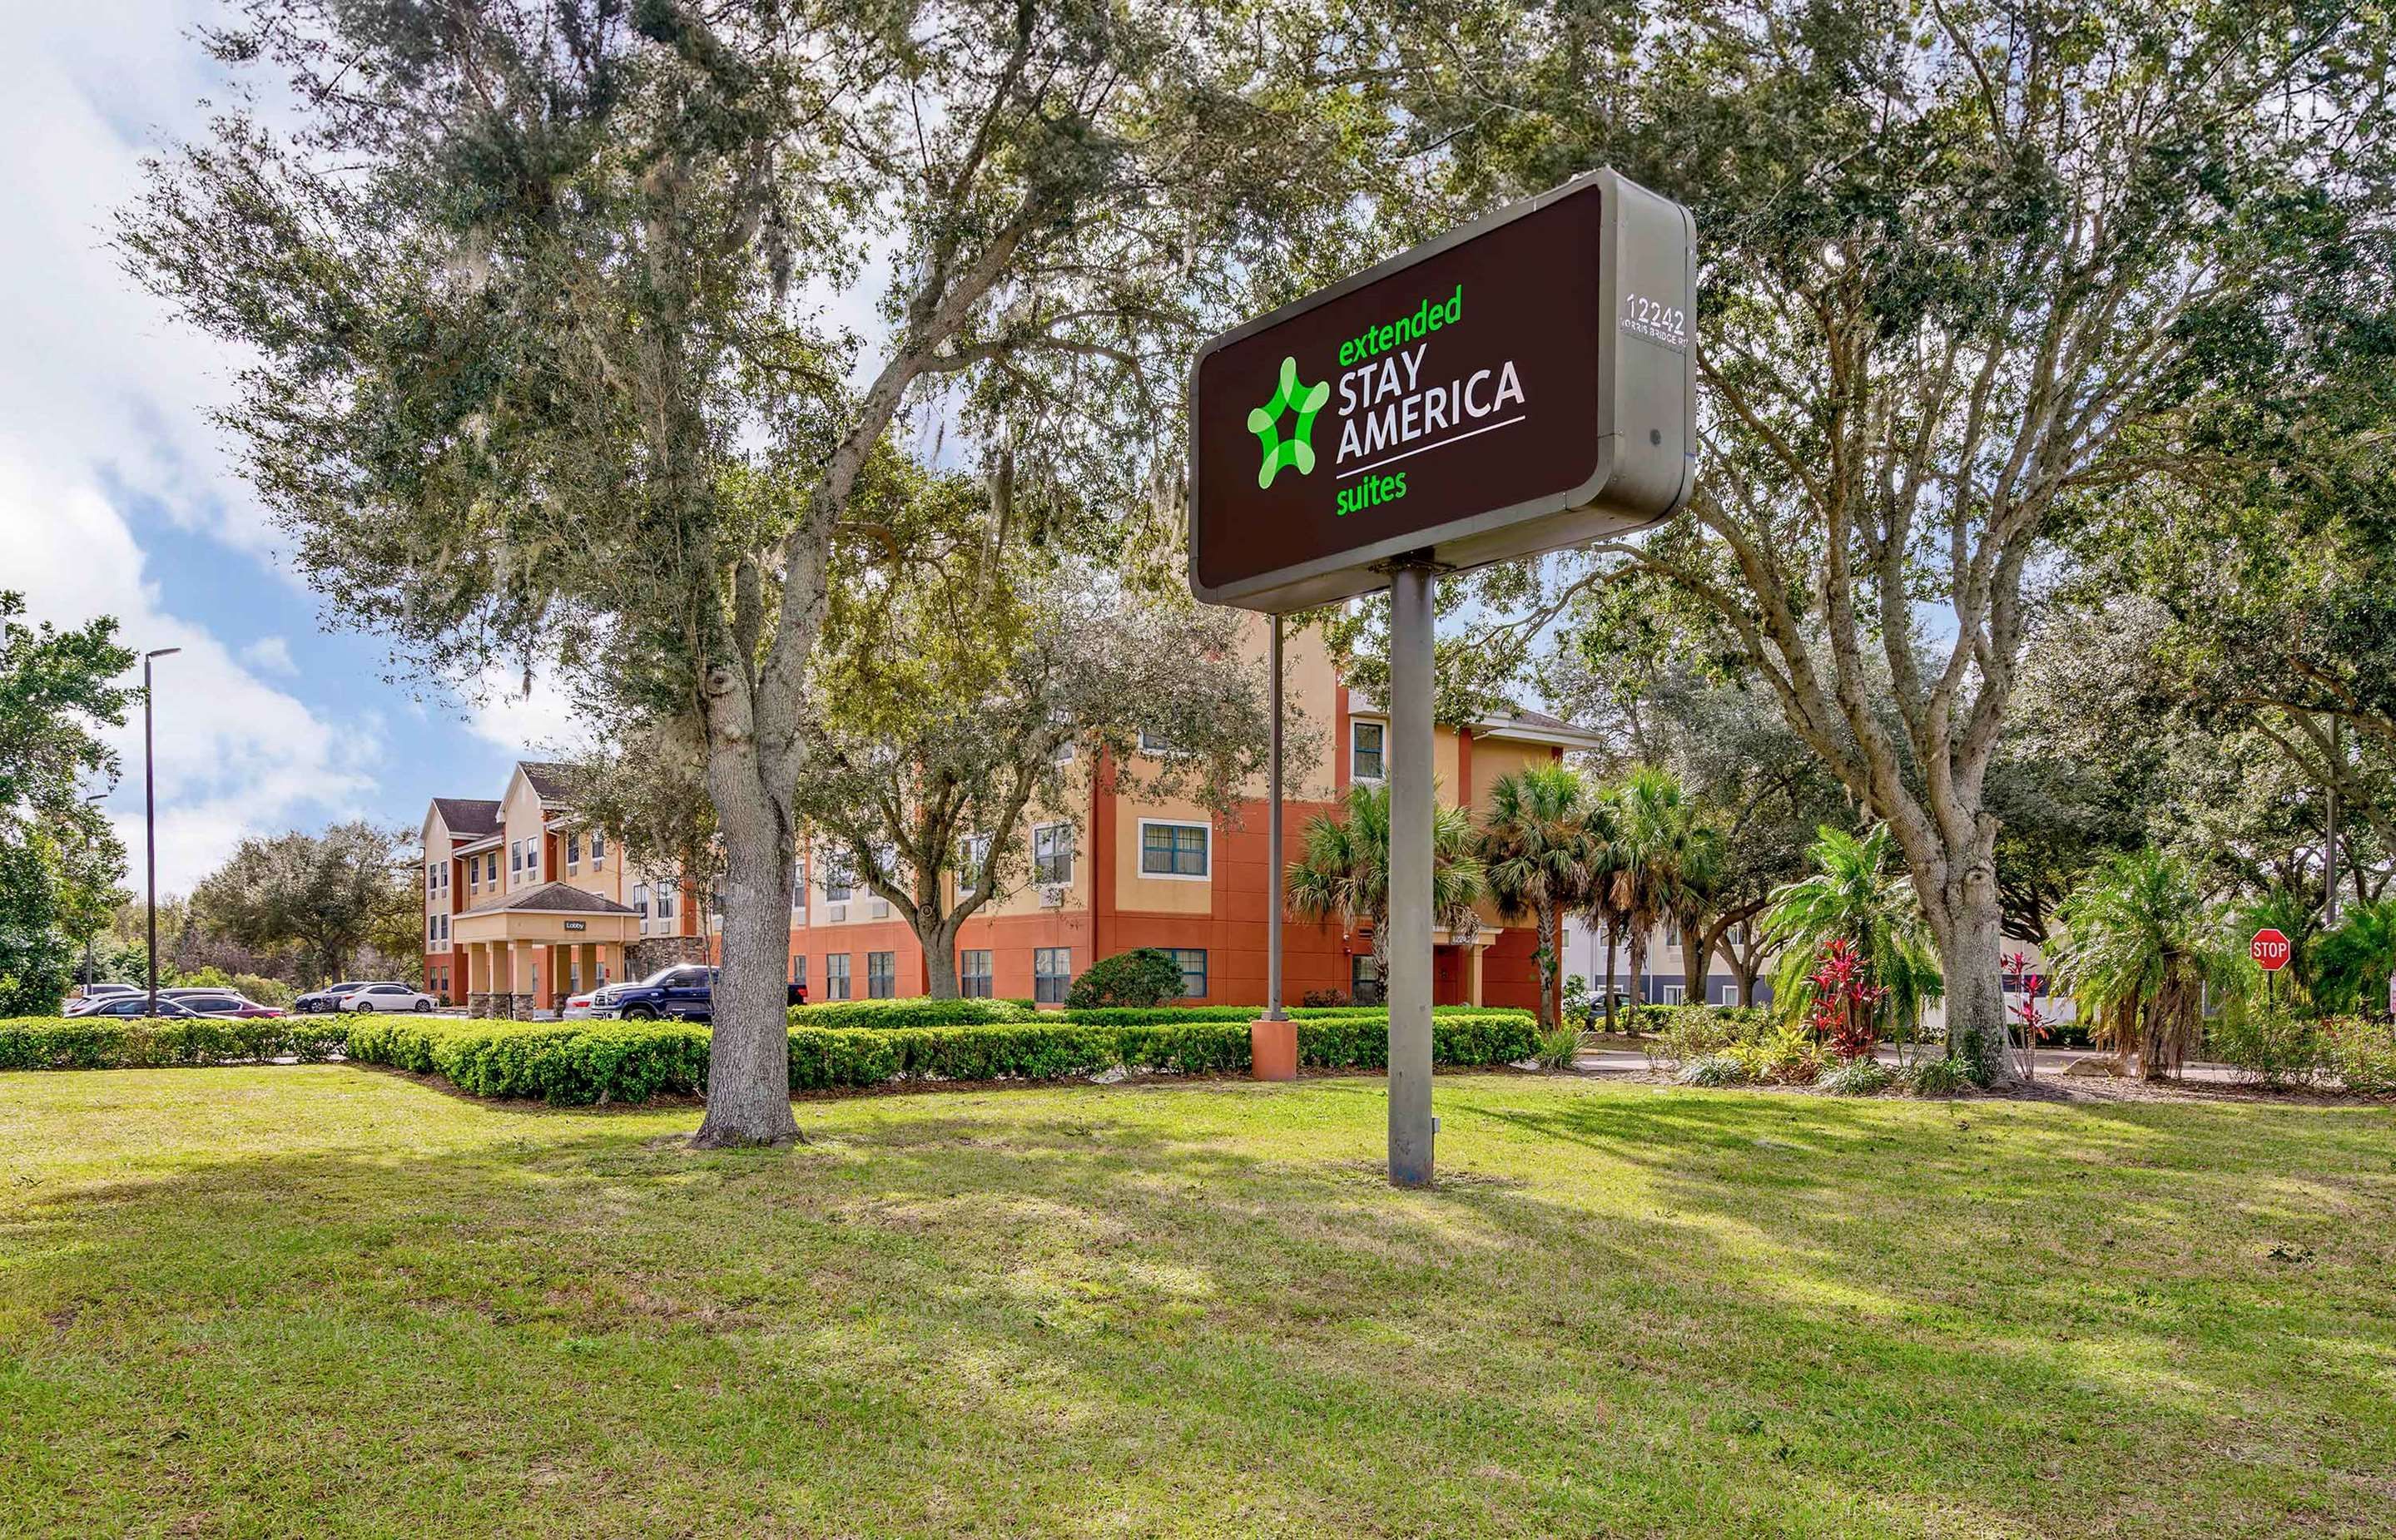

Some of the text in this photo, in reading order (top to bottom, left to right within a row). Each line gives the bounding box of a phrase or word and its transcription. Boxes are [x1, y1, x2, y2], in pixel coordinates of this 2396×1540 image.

[1339, 285, 1462, 366] extended
[1626, 293, 1684, 336] 12242
[1337, 343, 1427, 416] STAY
[1336, 360, 1525, 464] AMERICA
[1337, 472, 1407, 517] suites
[2253, 941, 2287, 958] STOP
